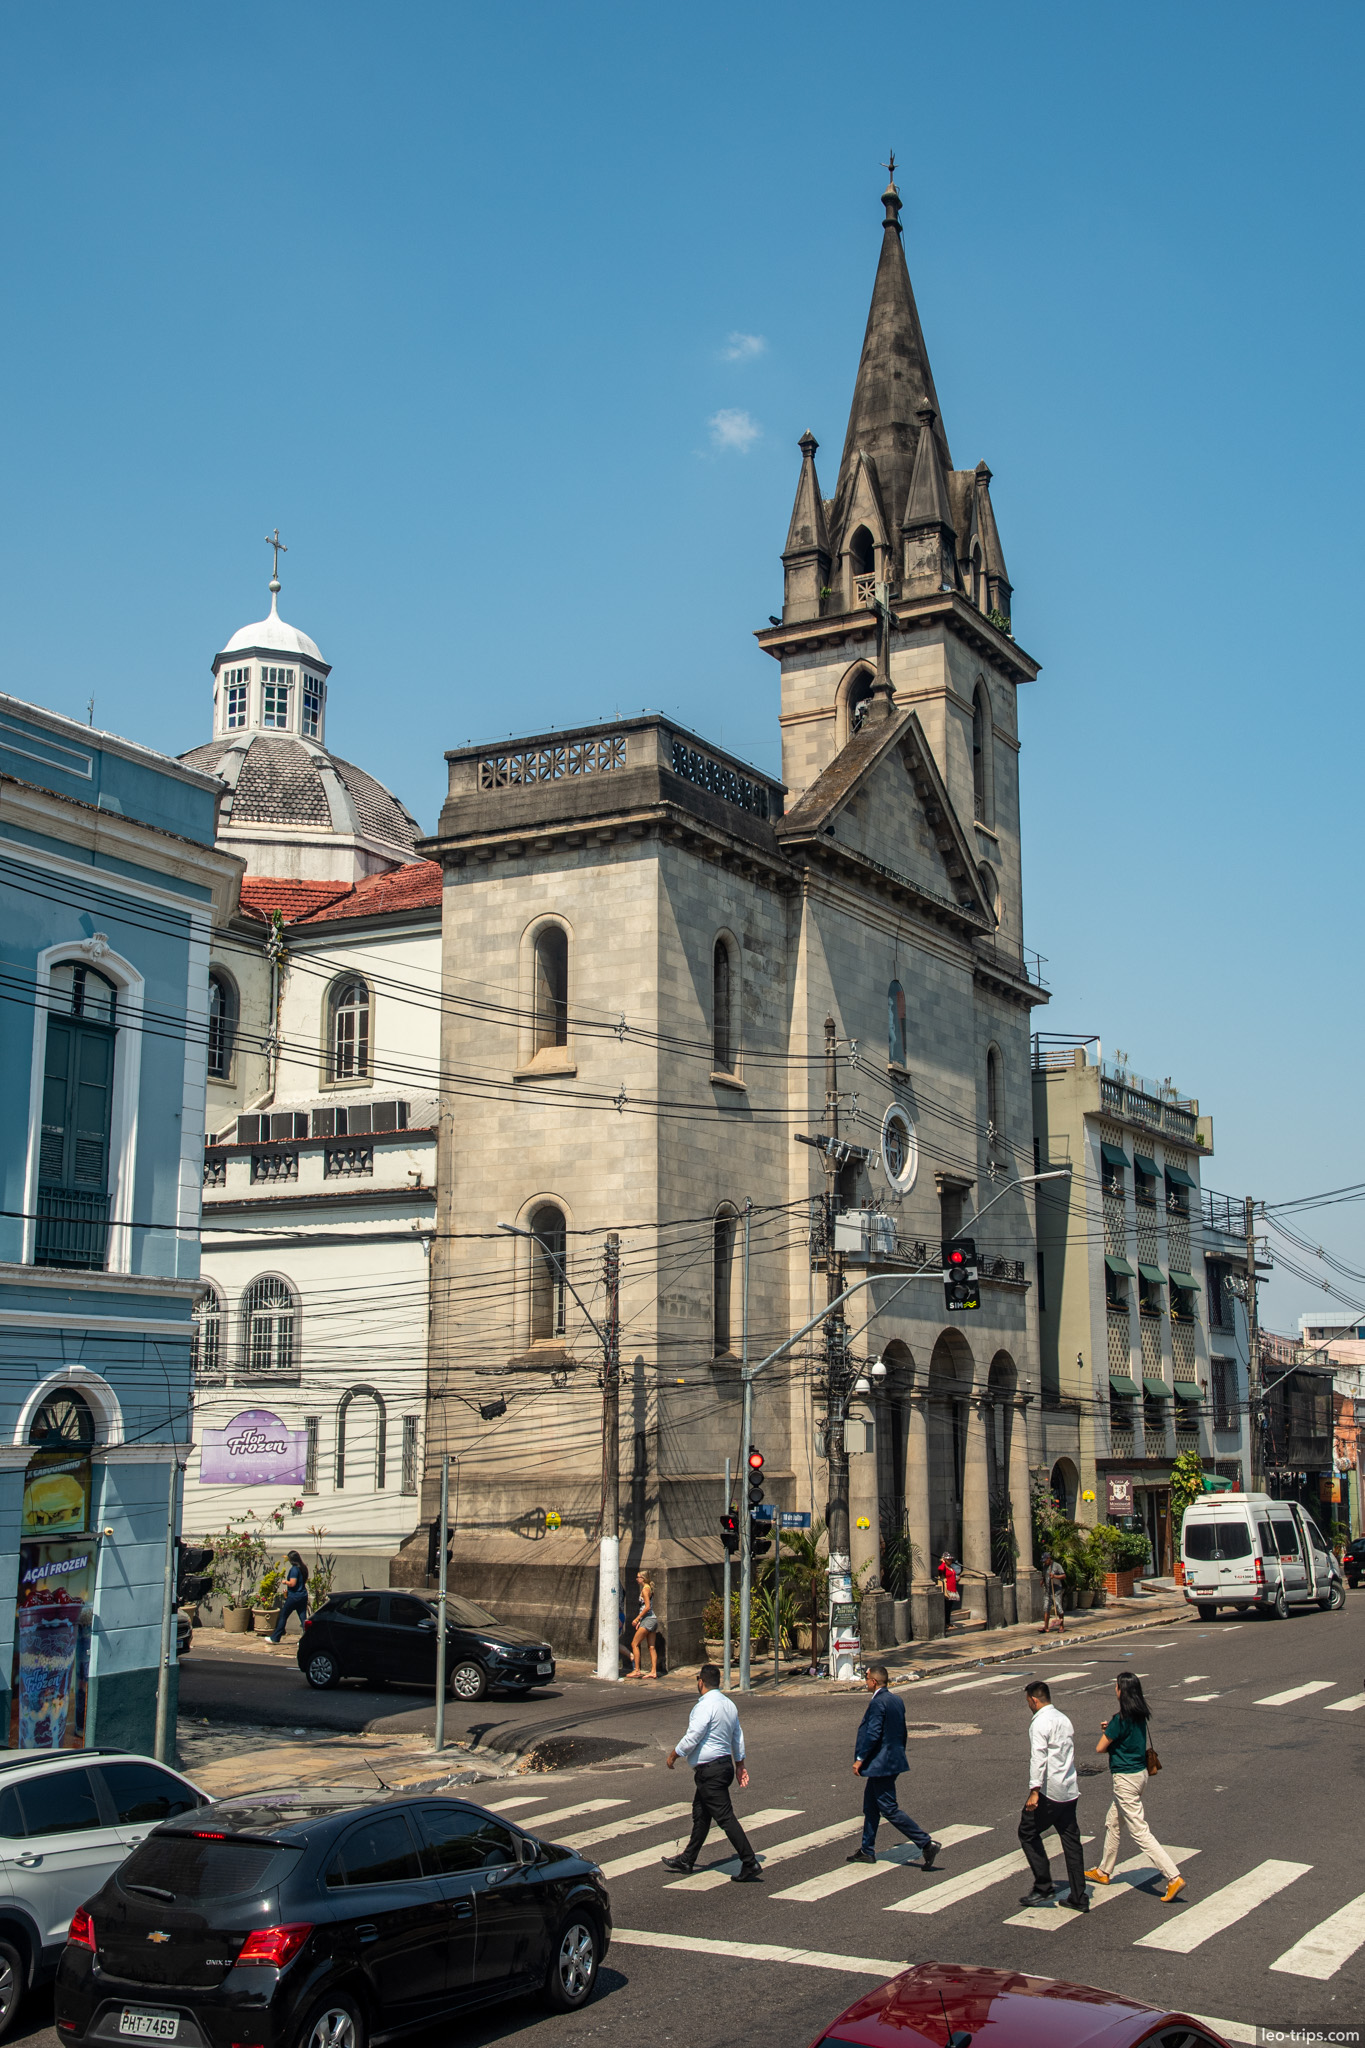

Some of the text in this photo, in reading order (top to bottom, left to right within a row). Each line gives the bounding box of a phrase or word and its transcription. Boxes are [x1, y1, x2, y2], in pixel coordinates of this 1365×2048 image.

[227, 1436, 287, 1455] Frozen
[241, 1427, 266, 1446] Top
[22, 1556, 88, 1583] AÇAÍ FROZEN
